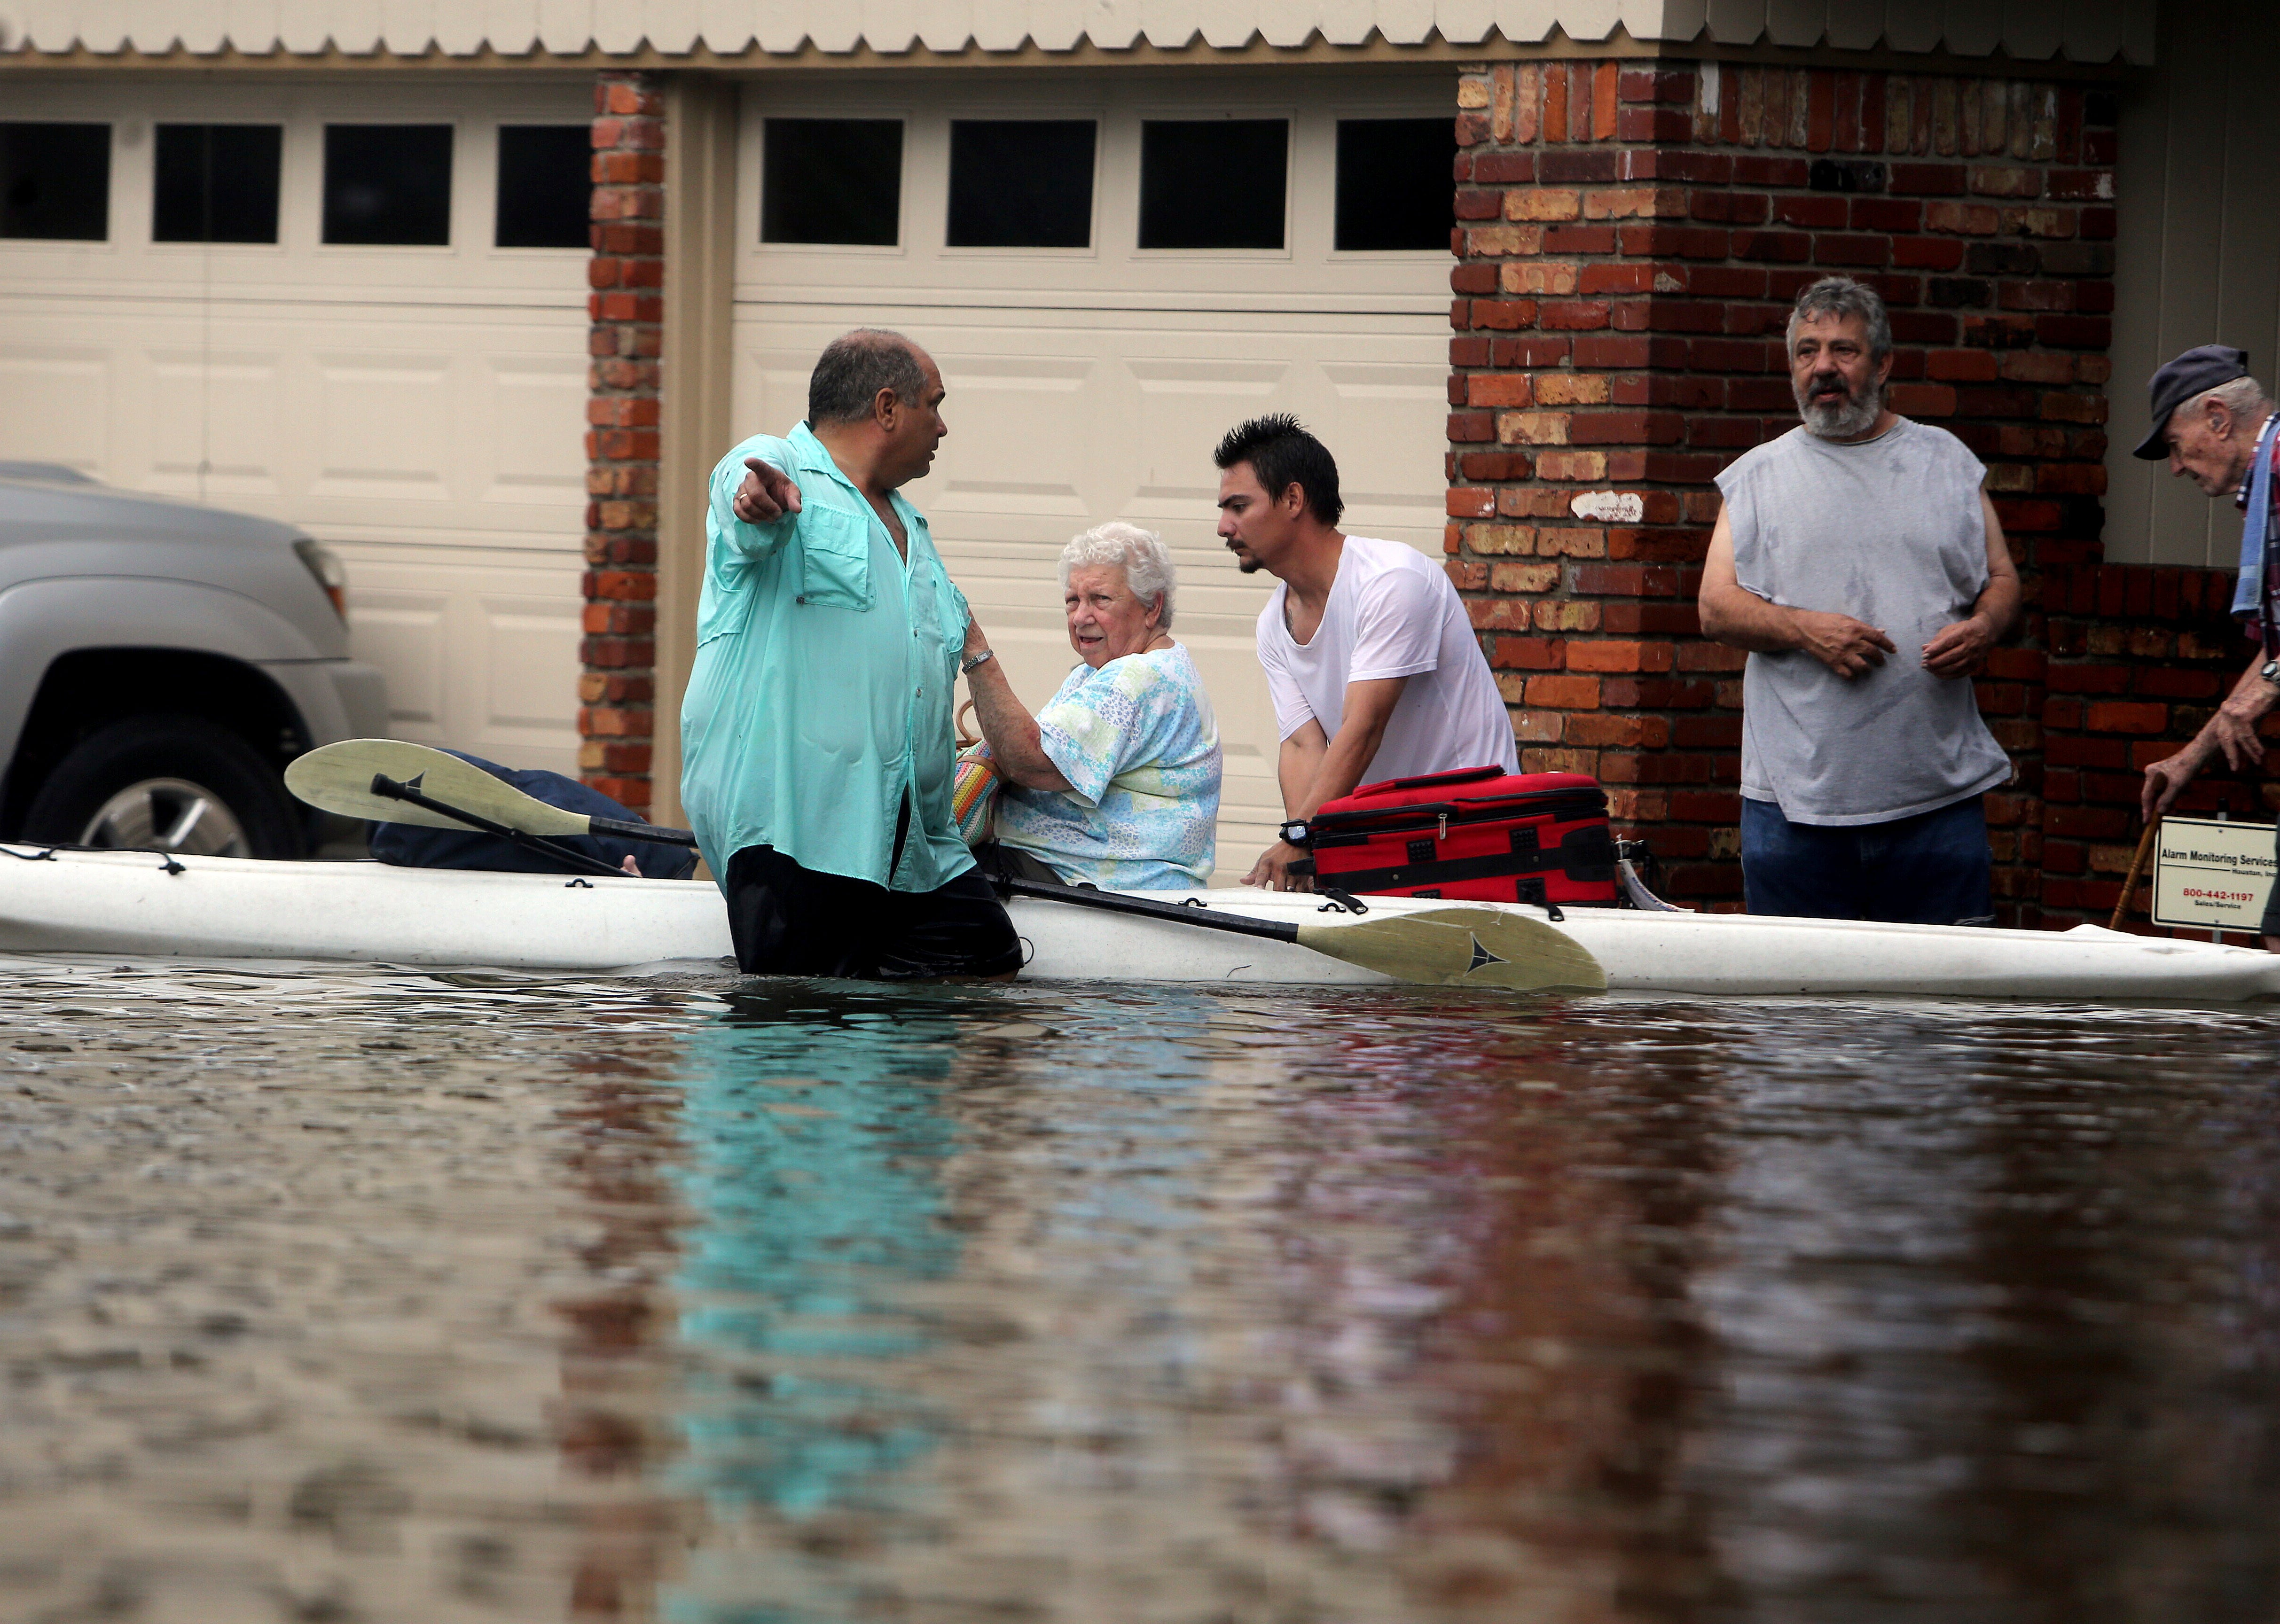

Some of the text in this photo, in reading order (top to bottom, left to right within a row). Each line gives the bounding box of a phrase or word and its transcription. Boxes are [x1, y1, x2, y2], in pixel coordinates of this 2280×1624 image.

[2162, 848, 2278, 867] Alarm Monitoring Services
[2183, 888, 2254, 901] 800-442-1197
[2194, 899, 2241, 909] Sales/Service
